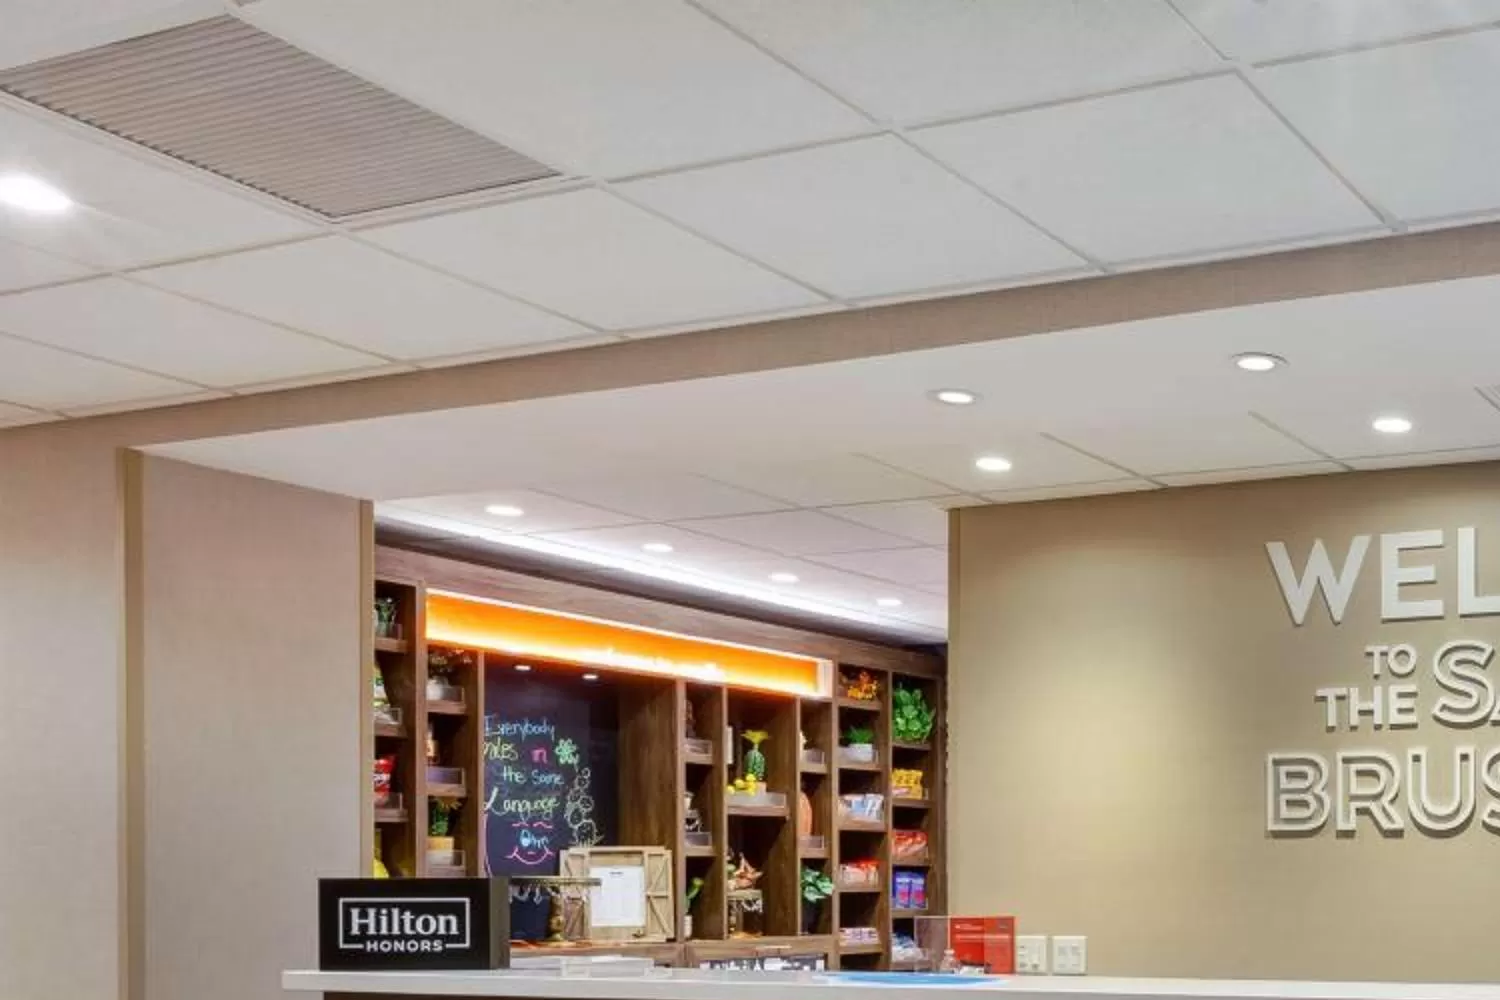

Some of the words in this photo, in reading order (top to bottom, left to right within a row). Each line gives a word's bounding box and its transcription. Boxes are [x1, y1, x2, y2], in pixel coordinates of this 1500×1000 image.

[1364, 643, 1418, 679] TO
[1315, 686, 1418, 730] THE
[350, 906, 459, 936] Hilton
[366, 938, 444, 953] HONORS
